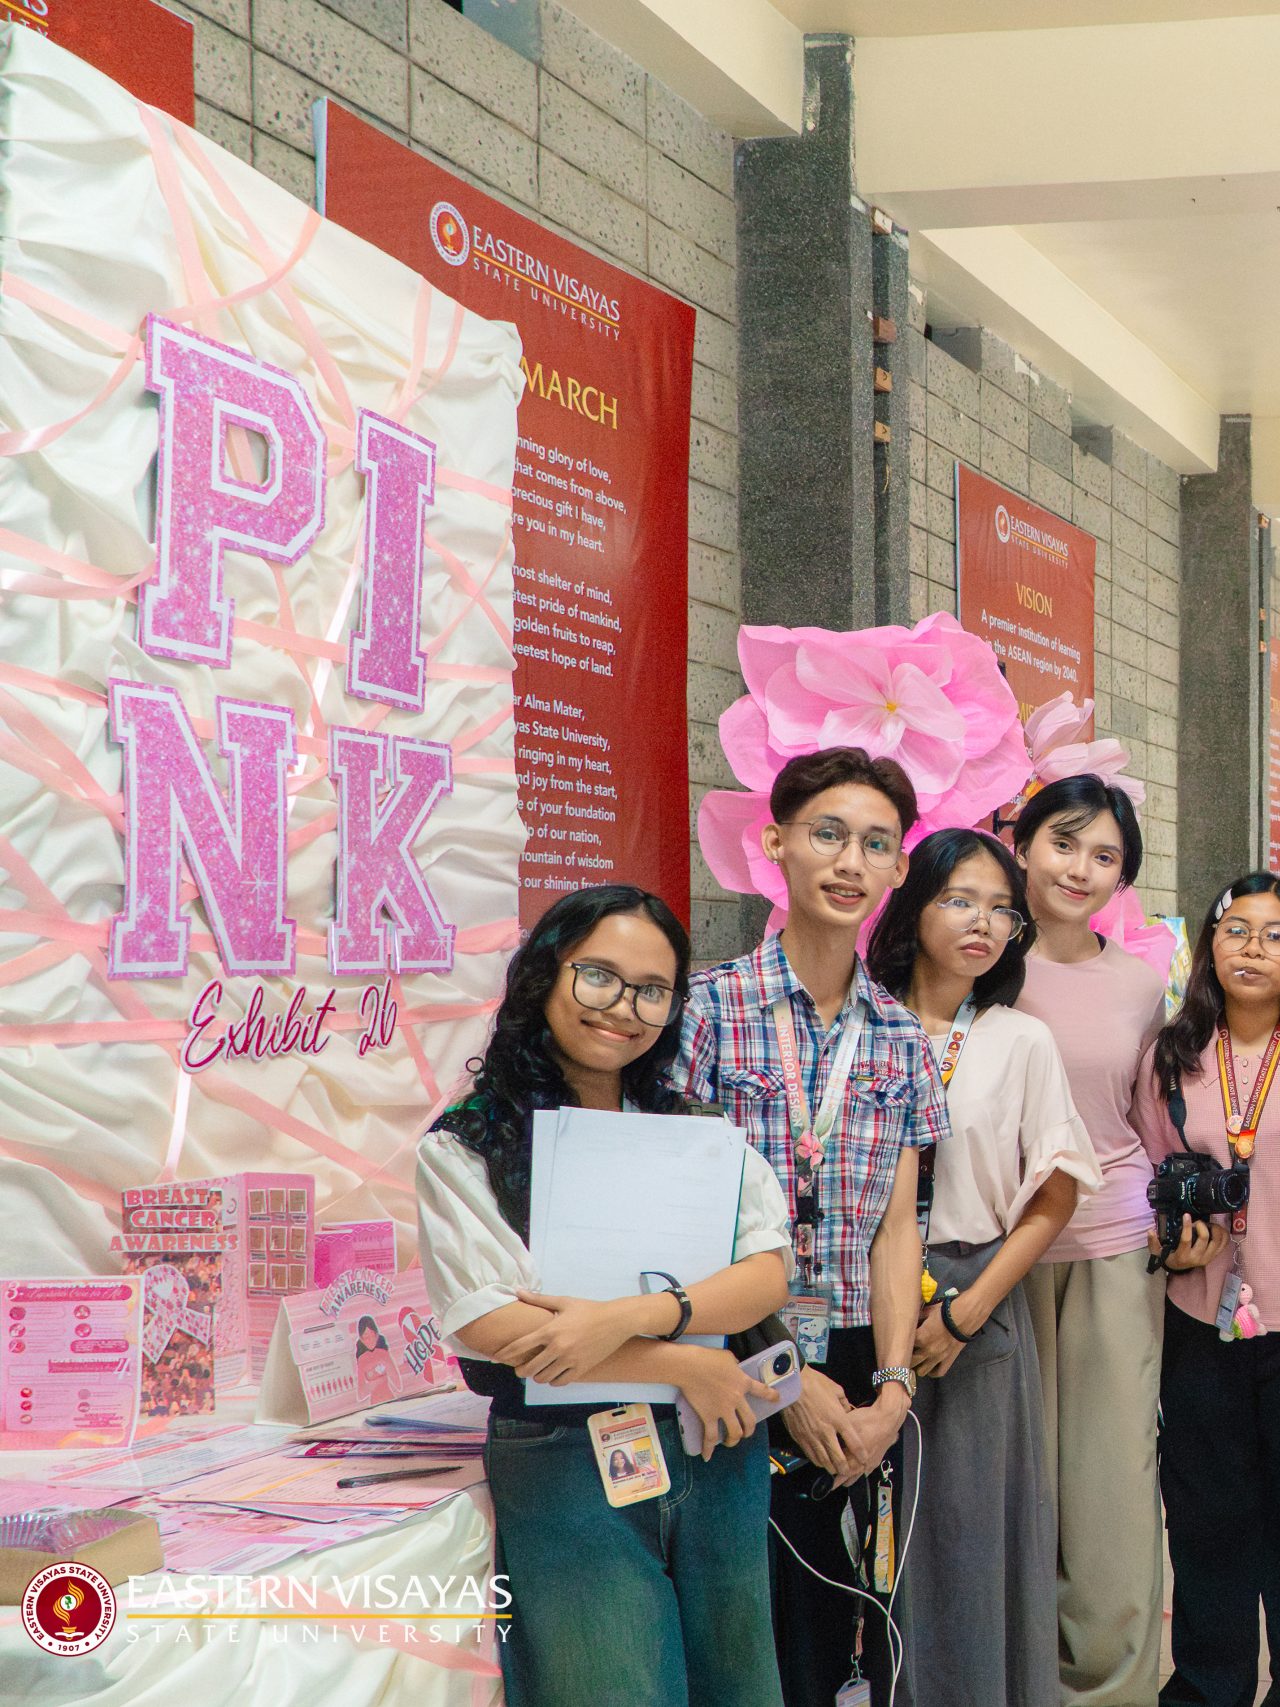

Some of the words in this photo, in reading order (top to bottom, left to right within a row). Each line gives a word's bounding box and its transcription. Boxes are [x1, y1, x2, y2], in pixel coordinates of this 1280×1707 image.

[473, 225, 549, 286] EASTERN
[553, 268, 620, 321] VISAYAS
[473, 257, 520, 291] STATE
[531, 287, 620, 341] UNIVERSITY
[520, 356, 618, 430] MARCH
[548, 447, 574, 471] glory
[576, 459, 588, 473] of
[588, 462, 612, 484] love,
[536, 469, 568, 490] comes
[569, 479, 594, 500] from
[595, 490, 627, 514] above,
[526, 516, 546, 533] you
[548, 520, 558, 537] in
[560, 529, 575, 546] my
[577, 530, 605, 553] heart.
[555, 501, 573, 519] gift
[575, 506, 579, 519] I
[581, 508, 607, 532] have,
[1010, 515, 1040, 543] EASTERN
[1041, 531, 1069, 557] VISAYAS
[537, 569, 572, 592] shelter
[573, 581, 585, 595] of
[586, 586, 613, 606] mind,
[1015, 582, 1053, 619] VISION
[539, 597, 565, 615] pride
[567, 604, 578, 619] of
[580, 612, 622, 634] mankind,
[514, 616, 550, 636] golden
[552, 623, 578, 644] fruits
[579, 632, 591, 647] to
[592, 638, 616, 656] reap,
[981, 609, 988, 624] A
[989, 615, 1017, 635] premier
[1018, 622, 1050, 648] institution
[1051, 637, 1058, 652] of
[1058, 638, 1081, 664] learning
[551, 647, 577, 669] hope
[579, 656, 590, 671] of
[591, 657, 614, 677] land.
[994, 639, 1006, 656] the
[1007, 644, 1032, 666] ASEAN
[1033, 656, 1054, 674] region
[1053, 662, 1061, 680] by
[524, 693, 551, 713] Alma
[553, 699, 585, 722] Mater,
[532, 720, 559, 739] State
[561, 726, 611, 752] University,
[518, 745, 554, 767] ringing
[556, 750, 566, 766] in
[568, 757, 583, 772] my
[585, 757, 612, 775] heart,
[532, 773, 549, 791] joy
[550, 773, 574, 792] from
[576, 779, 592, 795] the
[594, 782, 618, 800] start,
[527, 798, 538, 812] of
[540, 801, 563, 816] your
[565, 801, 616, 822] foundation
[537, 823, 548, 839] of
[551, 828, 567, 840] our
[569, 830, 602, 846] nation,
[565, 851, 576, 866] of
[577, 854, 614, 870] wisdom
[524, 877, 542, 888] our
[184, 979, 337, 1069] Exhibit
[779, 1024, 797, 1080] INTERIOR
[787, 1083, 804, 1127] DESIGN
[1244, 1105, 1256, 1128] EASTERN
[1251, 1083, 1263, 1104] VISAYAS
[1259, 1067, 1268, 1083] STATE
[125, 1188, 209, 1207] BREAST
[130, 1210, 218, 1229] CANCER
[110, 1233, 239, 1252] AWARENESS
[330, 1280, 389, 1319] AWARENESS
[404, 1316, 442, 1376] HOPE
